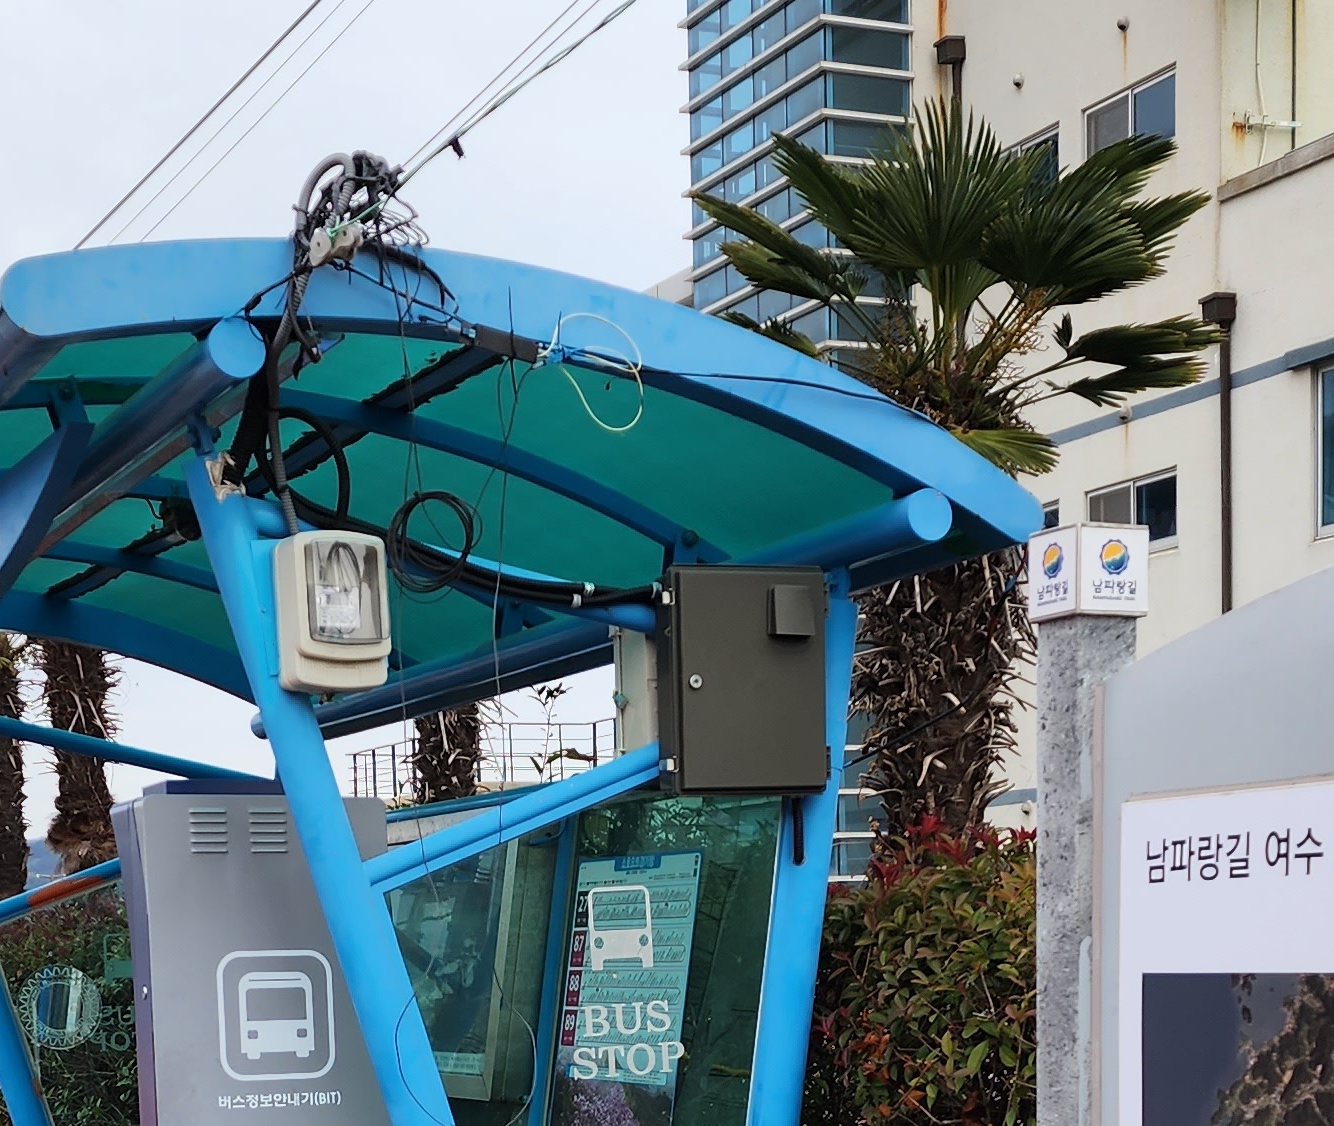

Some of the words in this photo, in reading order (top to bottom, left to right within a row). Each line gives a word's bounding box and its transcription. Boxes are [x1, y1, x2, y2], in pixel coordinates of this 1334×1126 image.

[1092, 579, 1137, 595] 남파랑길
[1146, 830, 1251, 885] 남파랑길
[1264, 827, 1325, 877] 여수
[582, 1000, 672, 1038] BUS
[572, 1040, 685, 1081] STOP
[218, 1091, 342, 1110] 버스정보안내기(BIT)
